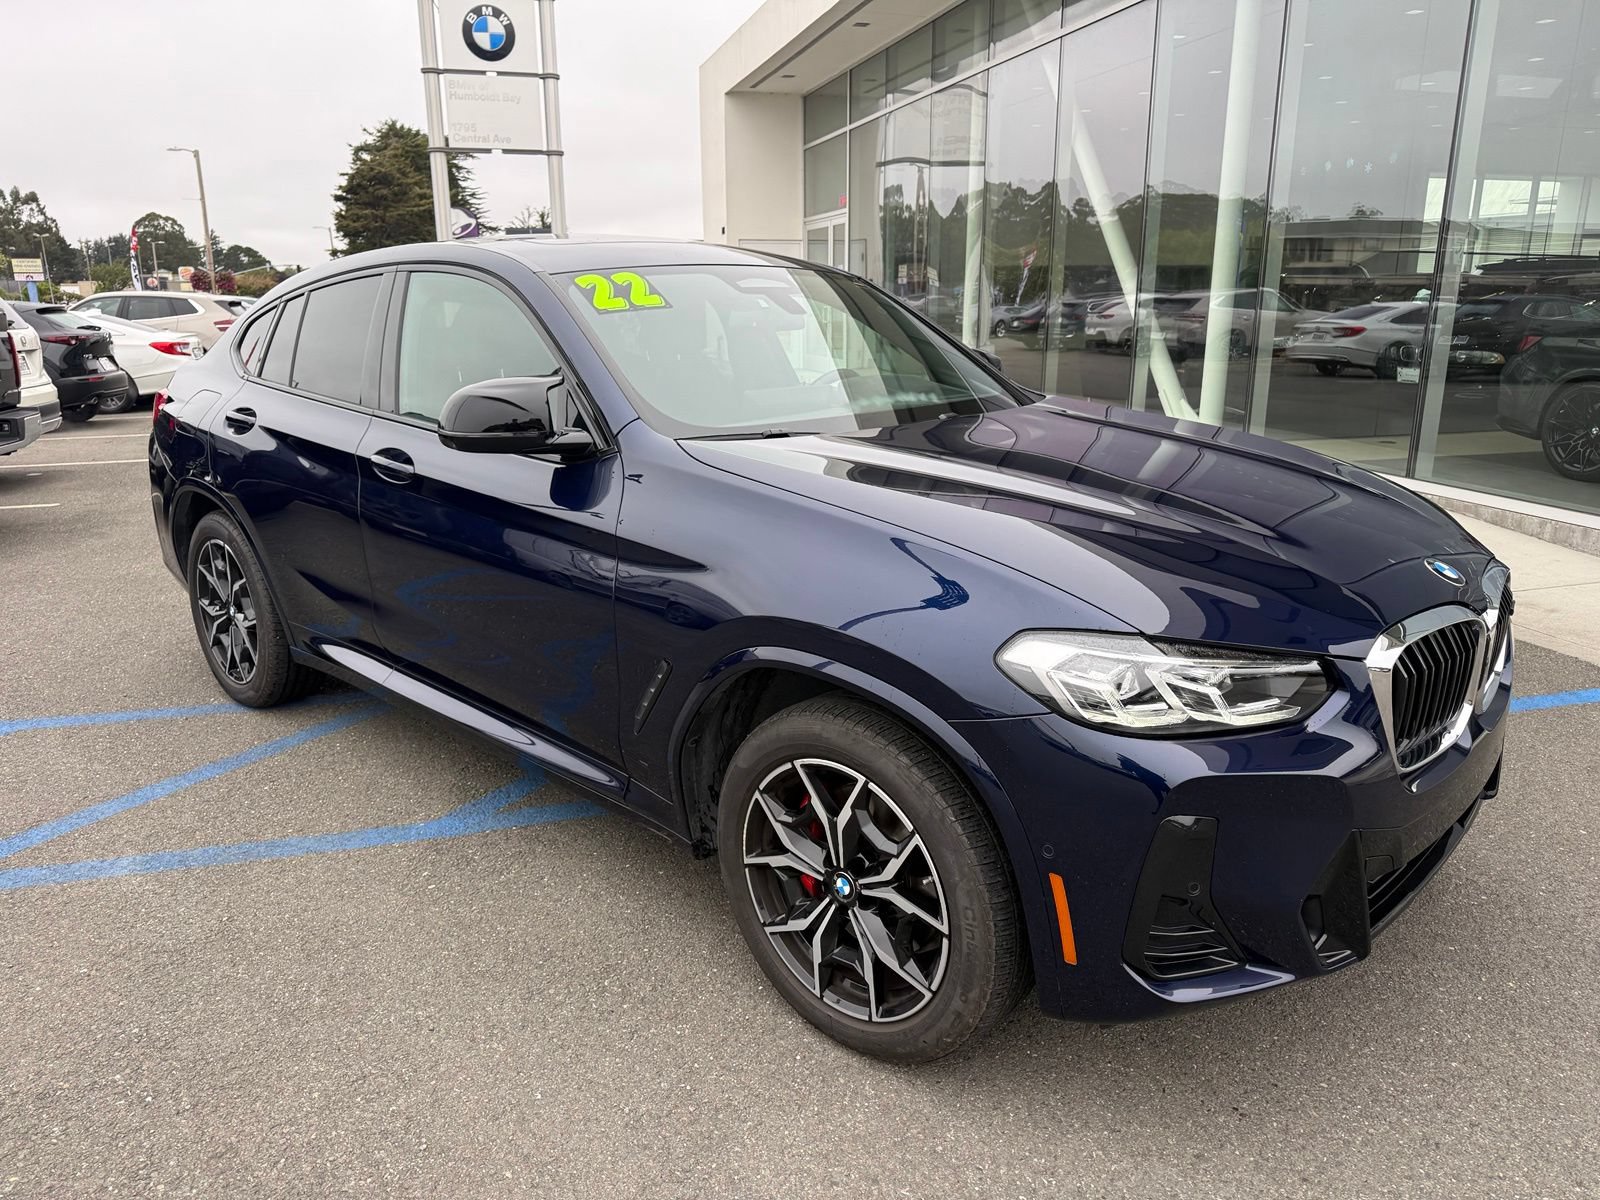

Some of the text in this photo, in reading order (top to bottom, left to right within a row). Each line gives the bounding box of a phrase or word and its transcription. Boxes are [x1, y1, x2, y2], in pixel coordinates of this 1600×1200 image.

[466, 6, 510, 25] BMW
[448, 79, 474, 91] BMW
[449, 90, 522, 105] Humboldt Bay
[451, 122, 477, 133] 1795
[453, 133, 512, 144] Central Ave
[574, 272, 665, 310] 22
